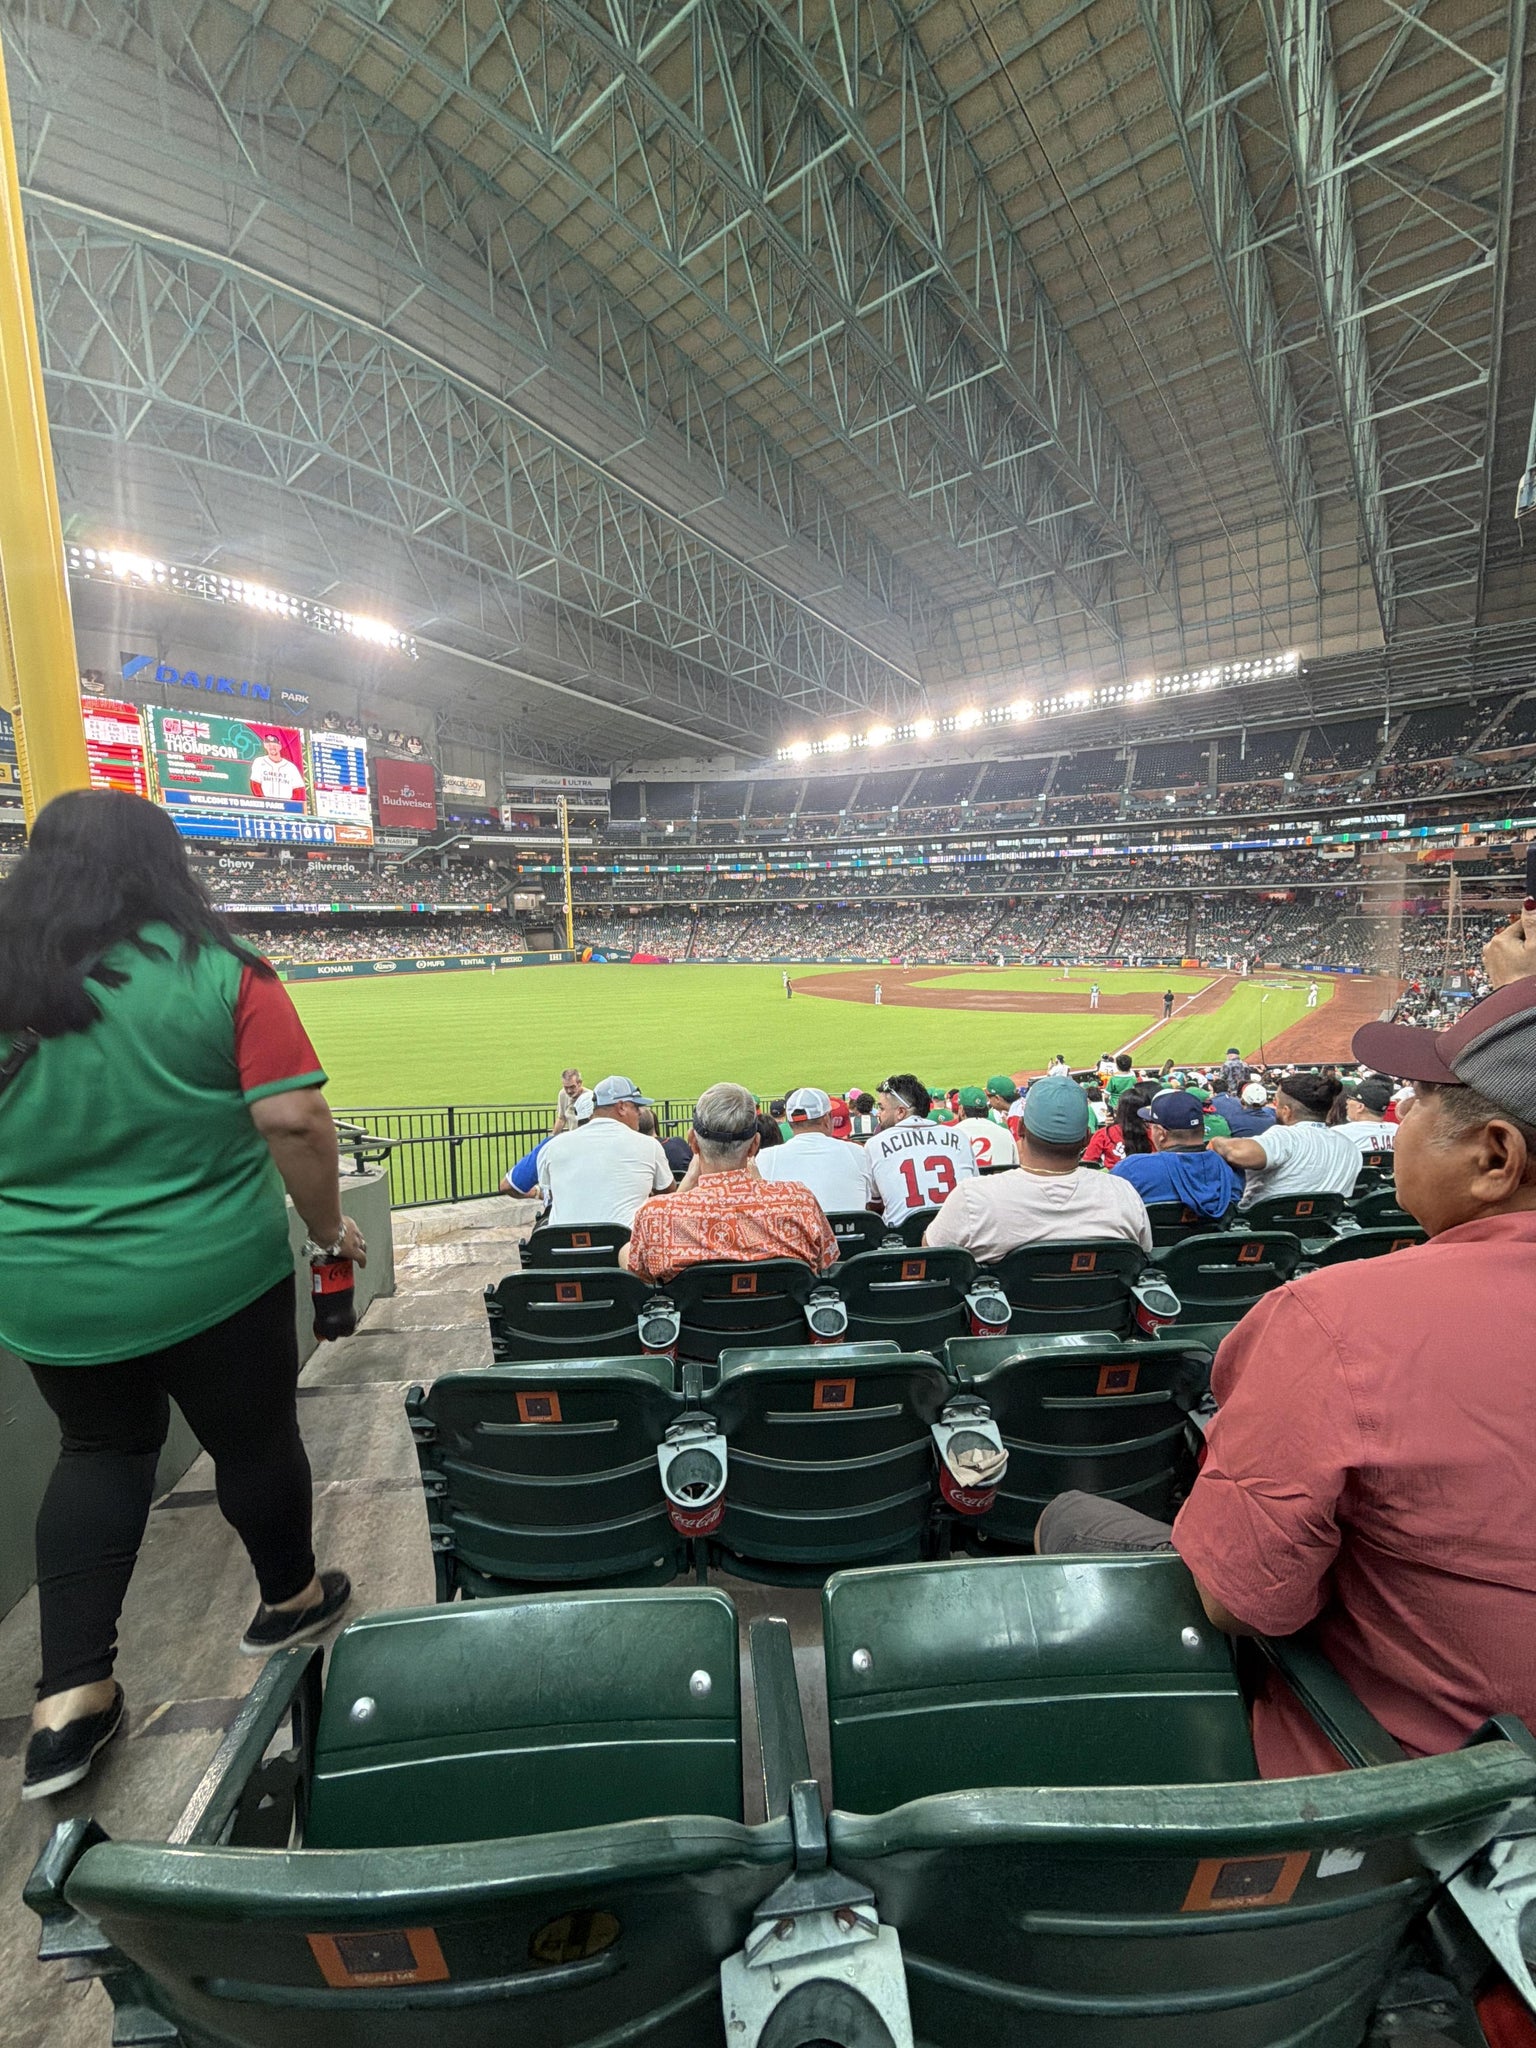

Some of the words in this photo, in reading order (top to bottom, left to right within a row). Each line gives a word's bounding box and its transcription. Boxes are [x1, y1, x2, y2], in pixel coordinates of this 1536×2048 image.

[155, 664, 272, 701] DAIKIN
[281, 691, 310, 704] PARK
[164, 738, 238, 758] THOMPSON
[189, 795, 228, 805] WELCOME
[229, 798, 240, 806] TO
[265, 801, 285, 809] PARK
[382, 795, 432, 808] Budweiser
[303, 826, 312, 838] 0
[313, 827, 320, 839] 1
[324, 827, 333, 839] 0
[218, 858, 255, 870] Chevy
[308, 862, 356, 872] Silverado
[318, 965, 354, 974] KONAMI
[940, 1132, 960, 1151] JR.
[900, 1155, 957, 1208] 13
